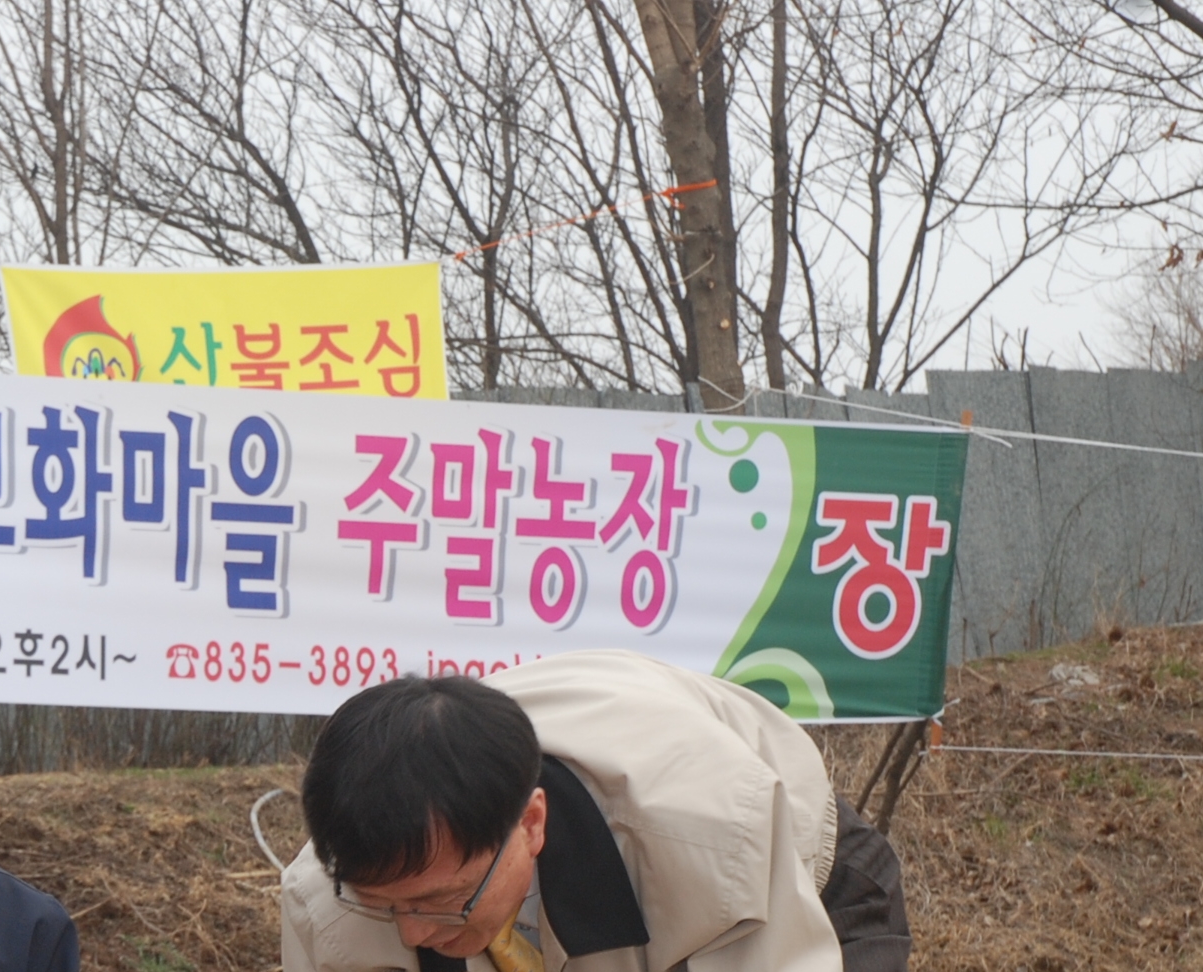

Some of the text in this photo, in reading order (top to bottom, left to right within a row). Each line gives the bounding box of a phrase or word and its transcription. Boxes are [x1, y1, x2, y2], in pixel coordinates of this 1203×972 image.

[159, 313, 421, 398] 산불조심
[338, 427, 689, 628] 주말농장
[814, 493, 949, 657] 장
